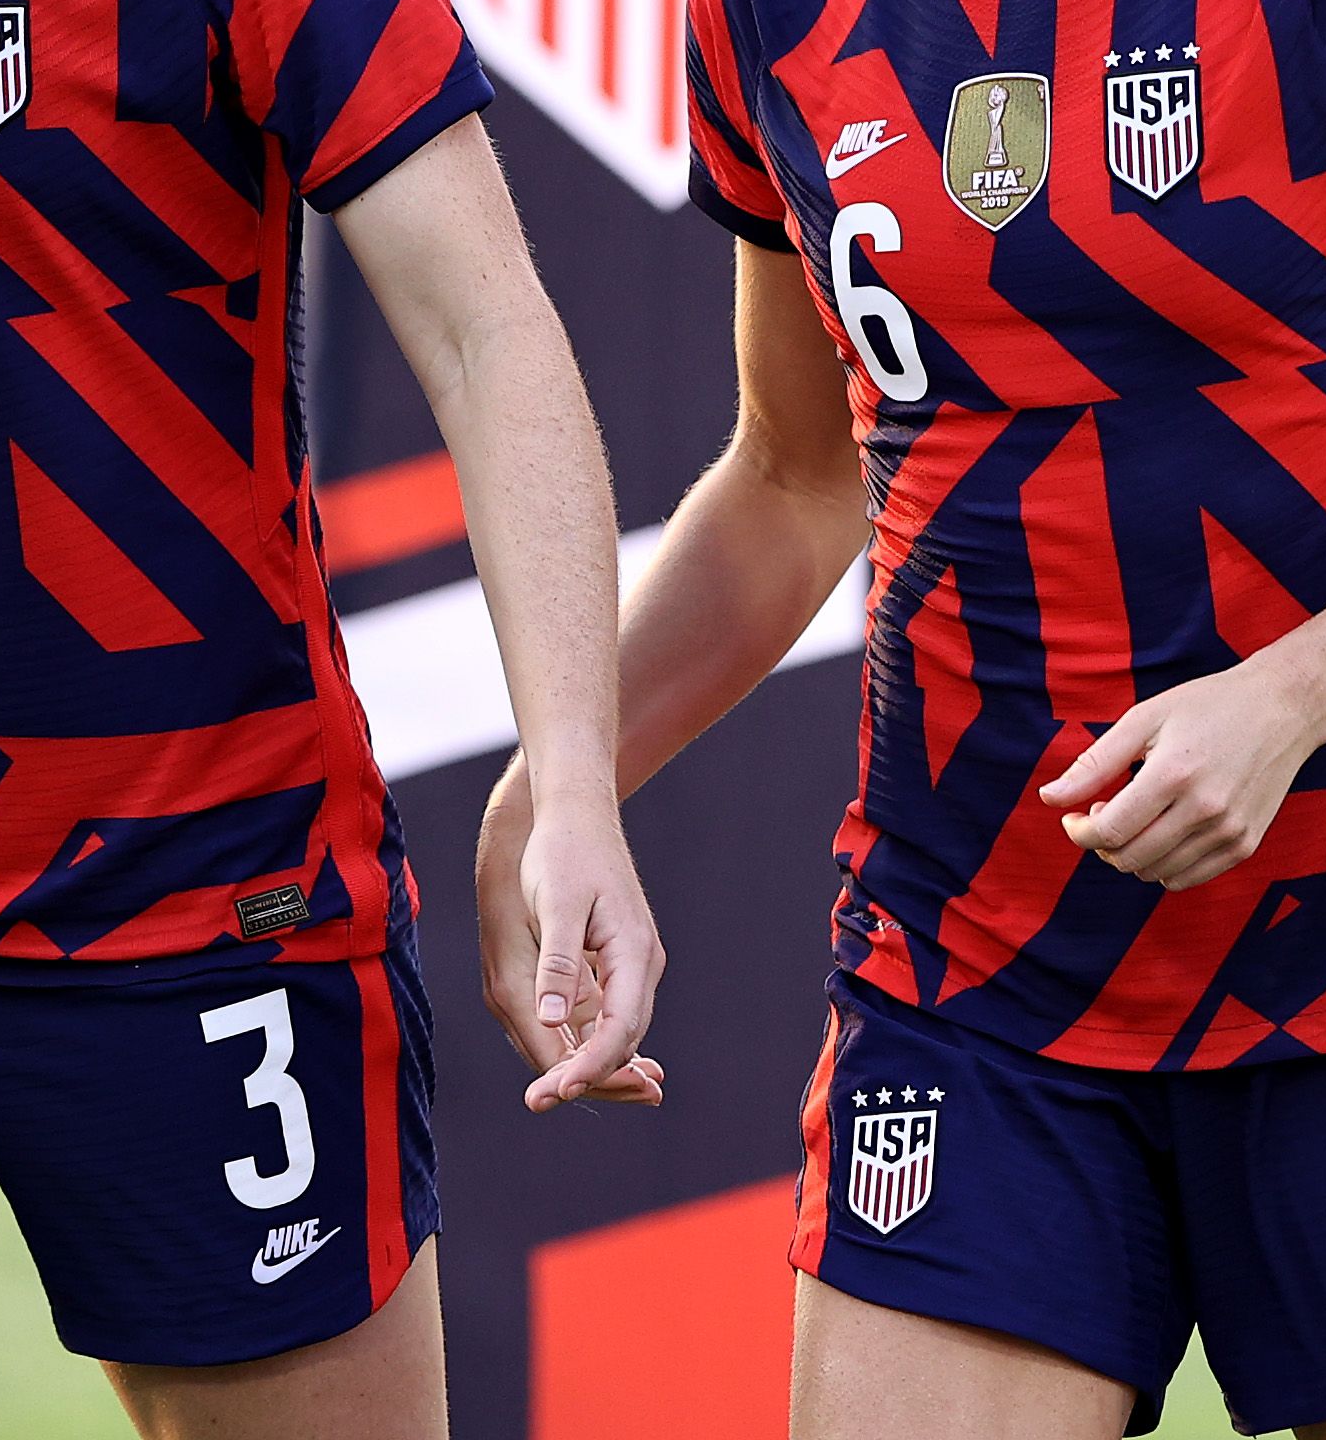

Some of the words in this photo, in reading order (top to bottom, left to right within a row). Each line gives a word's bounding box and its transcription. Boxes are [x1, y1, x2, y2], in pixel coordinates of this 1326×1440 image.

[1112, 75, 1190, 126] USA
[834, 119, 888, 155] NIKE
[961, 189, 986, 199] WORLD
[987, 186, 1029, 196] CHAMPIONS
[972, 169, 1018, 190] FIFA
[980, 196, 1009, 209] 2019
[830, 202, 928, 402] 6
[199, 988, 315, 1209] 3
[858, 1115, 932, 1164] USA
[264, 1218, 320, 1261] NIKE
